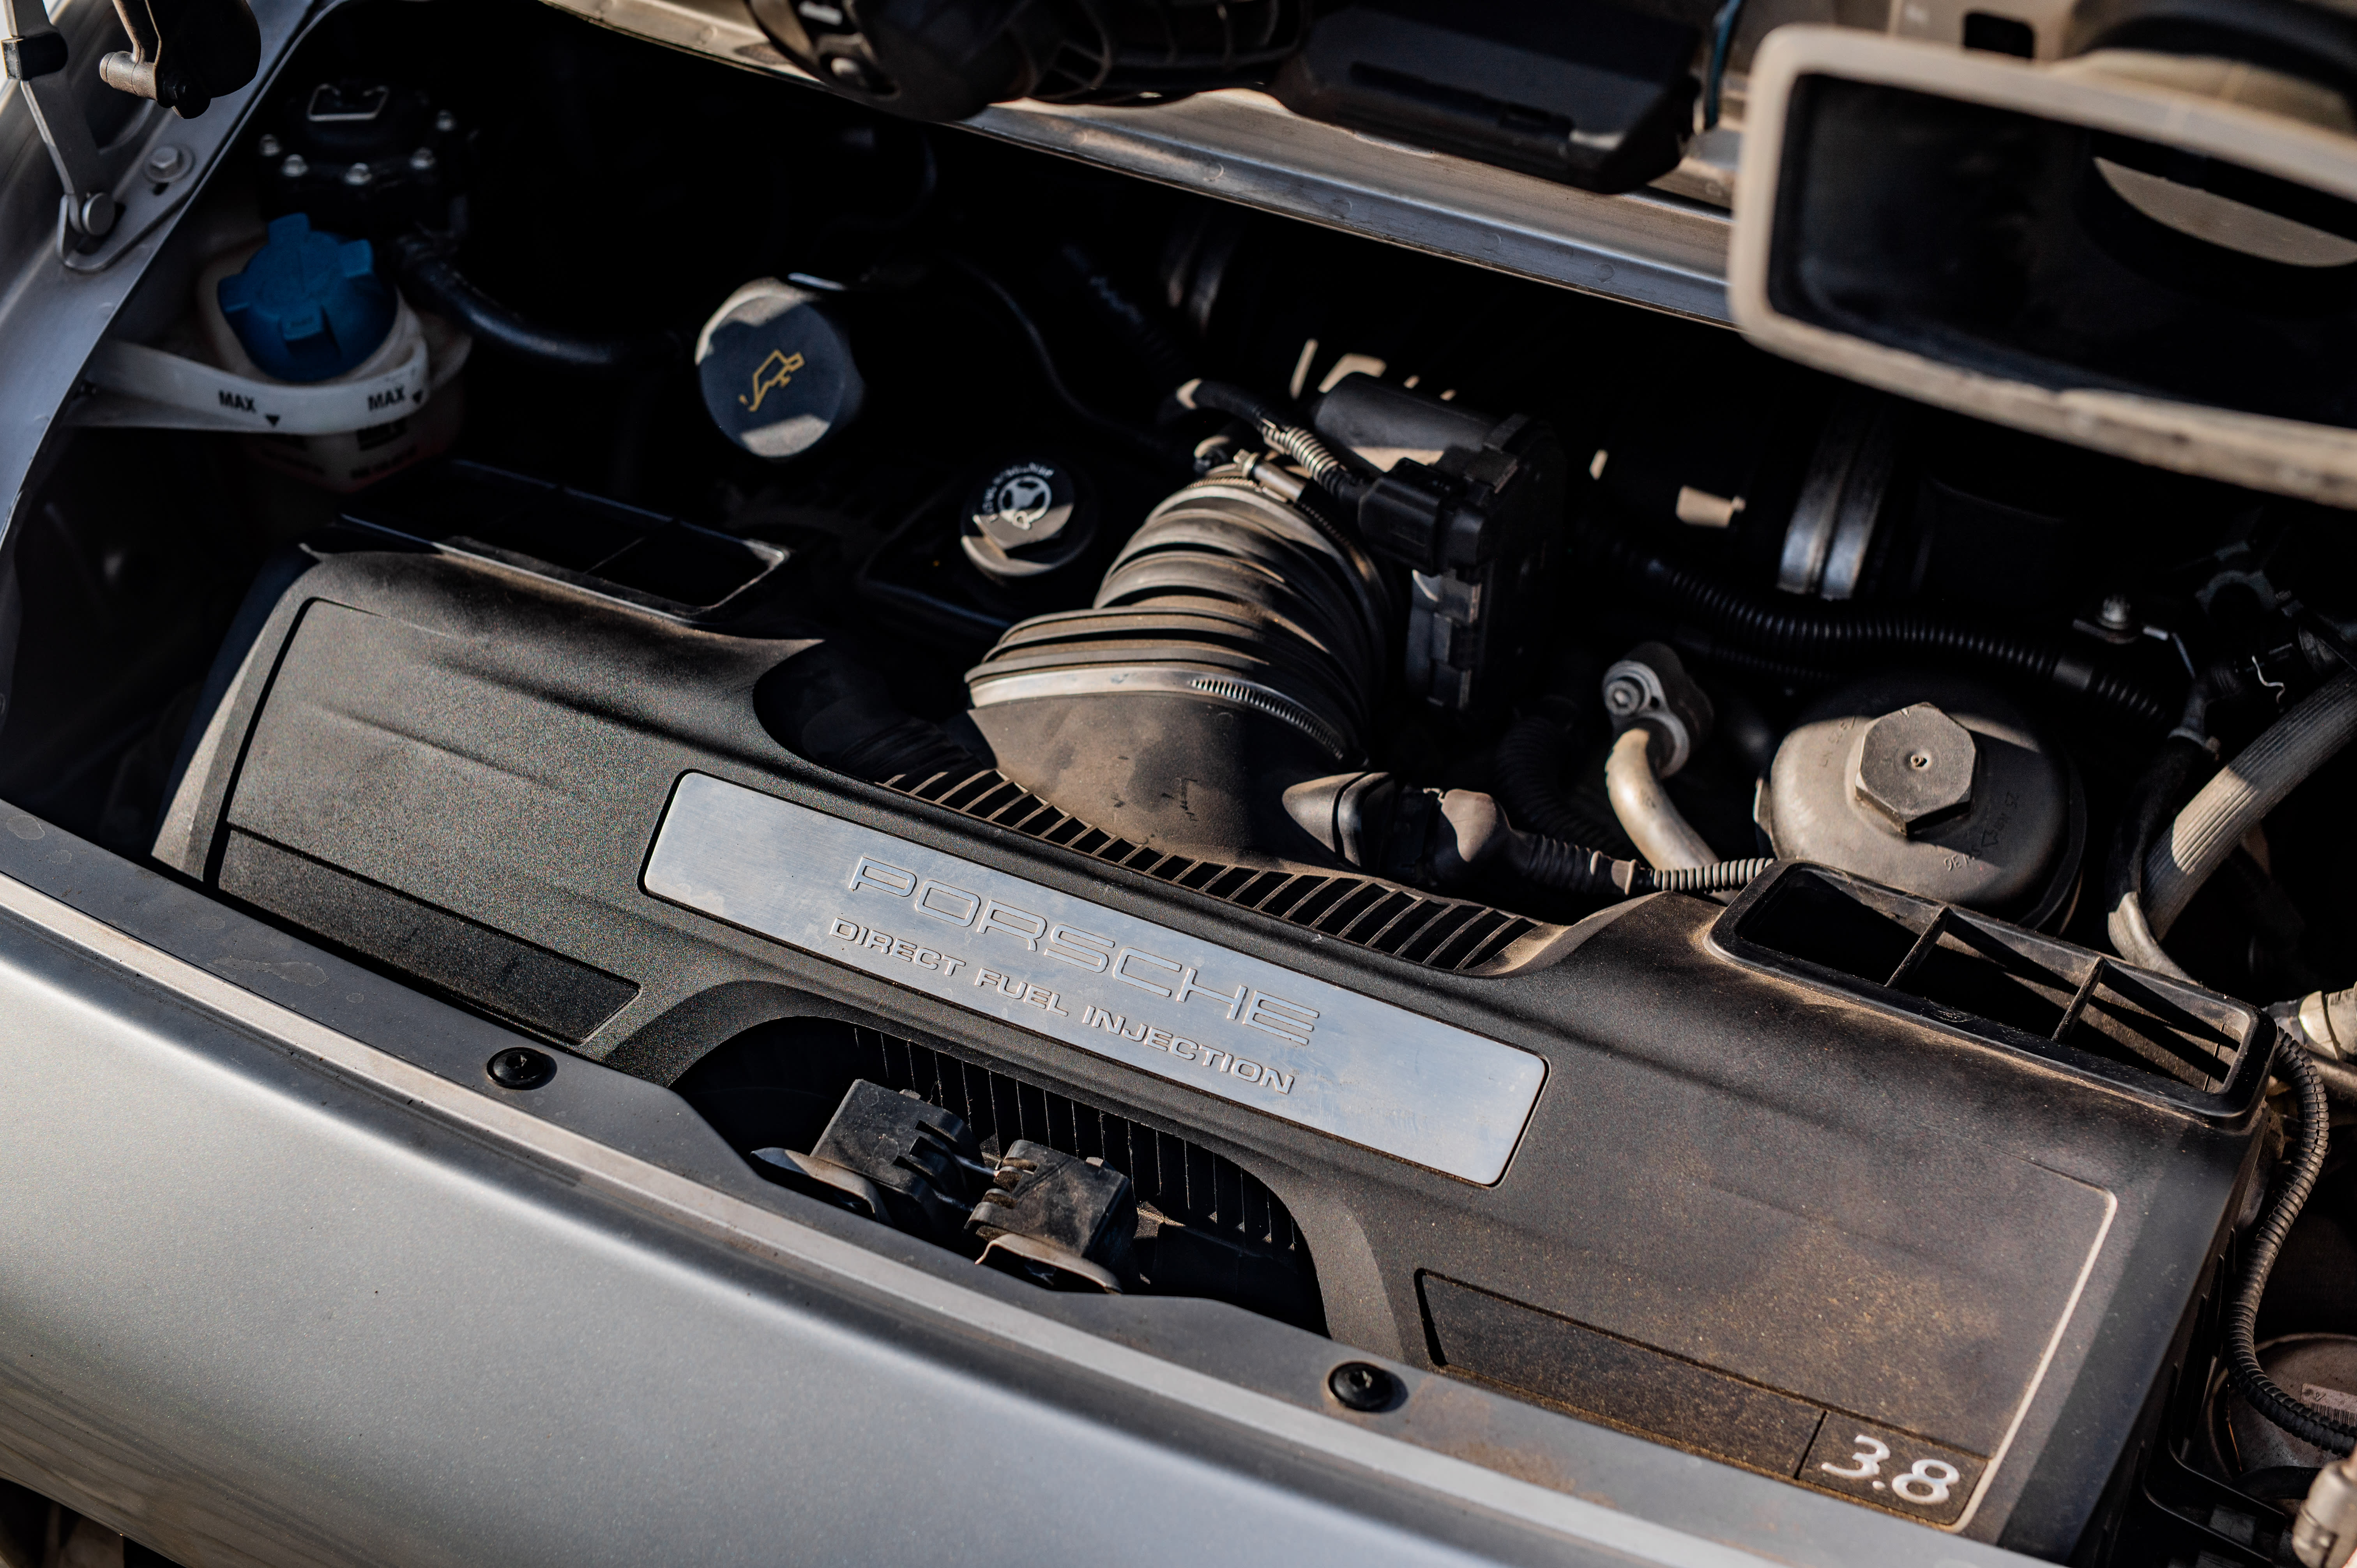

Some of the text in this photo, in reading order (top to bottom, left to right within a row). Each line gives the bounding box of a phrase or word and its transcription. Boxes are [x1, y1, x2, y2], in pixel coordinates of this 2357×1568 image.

[219, 390, 256, 413] MAX
[368, 387, 405, 411] MAX
[848, 856, 1319, 1045] PORSCHE
[829, 918, 1294, 1094] DIRECT FUEL INJECTION
[1821, 1434, 1960, 1504] 3.8
